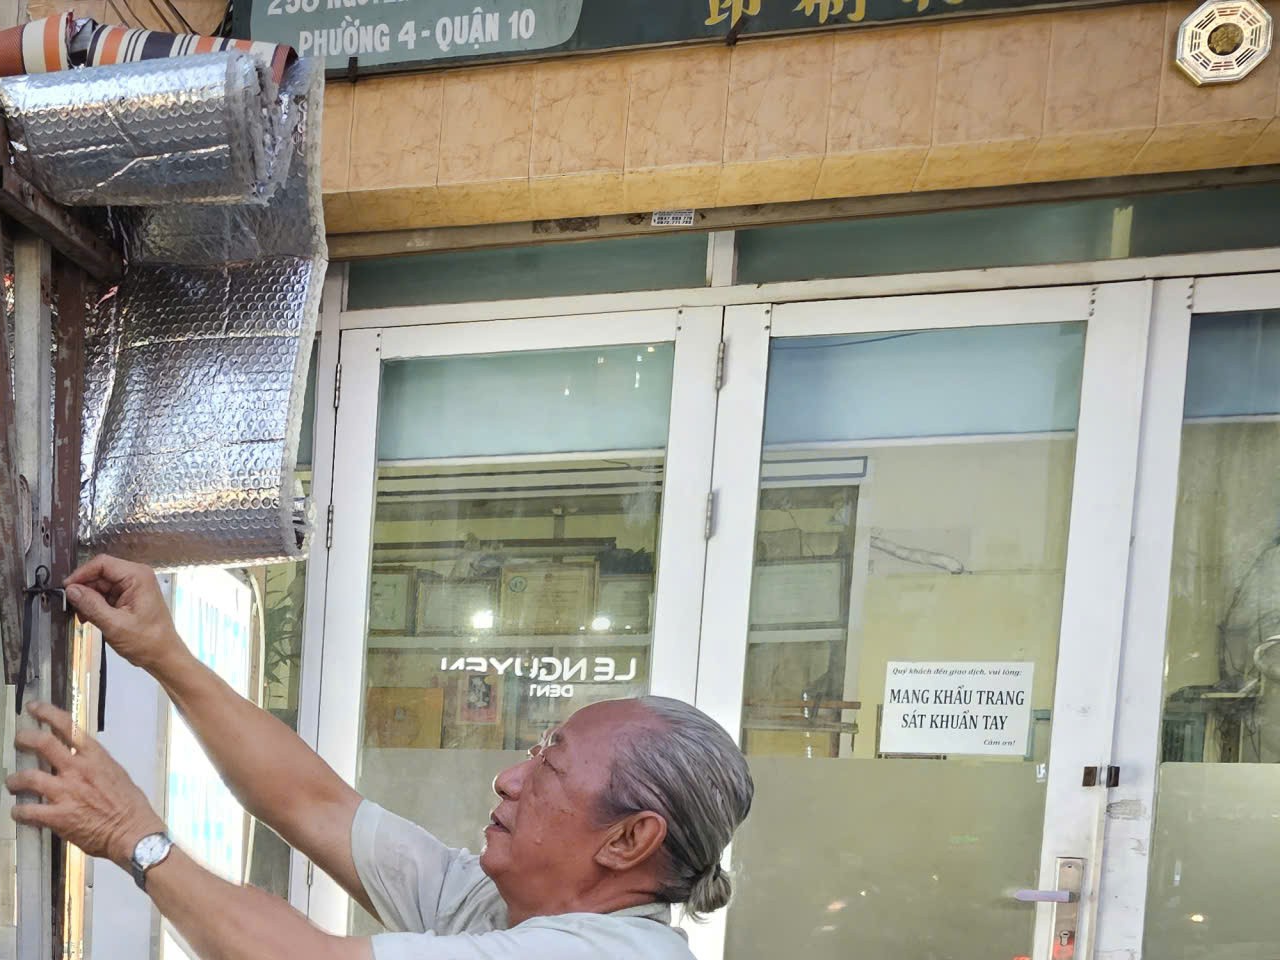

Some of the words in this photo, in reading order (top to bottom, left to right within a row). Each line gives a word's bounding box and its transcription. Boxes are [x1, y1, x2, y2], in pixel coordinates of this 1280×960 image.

[298, 16, 390, 57] PHƯỜNG
[397, 21, 416, 50] 4
[435, 6, 499, 51] QUẬN
[508, 8, 536, 39] 10
[892, 667, 907, 676] Quý
[909, 667, 932, 675] khách
[934, 667, 948, 675] đến
[889, 689, 930, 704] MANG
[933, 685, 973, 705] KHẨU
[977, 690, 1025, 706] TRANG
[901, 709, 926, 729] SÁT
[929, 709, 978, 730] KHUẨN
[983, 715, 1008, 730] TAY
